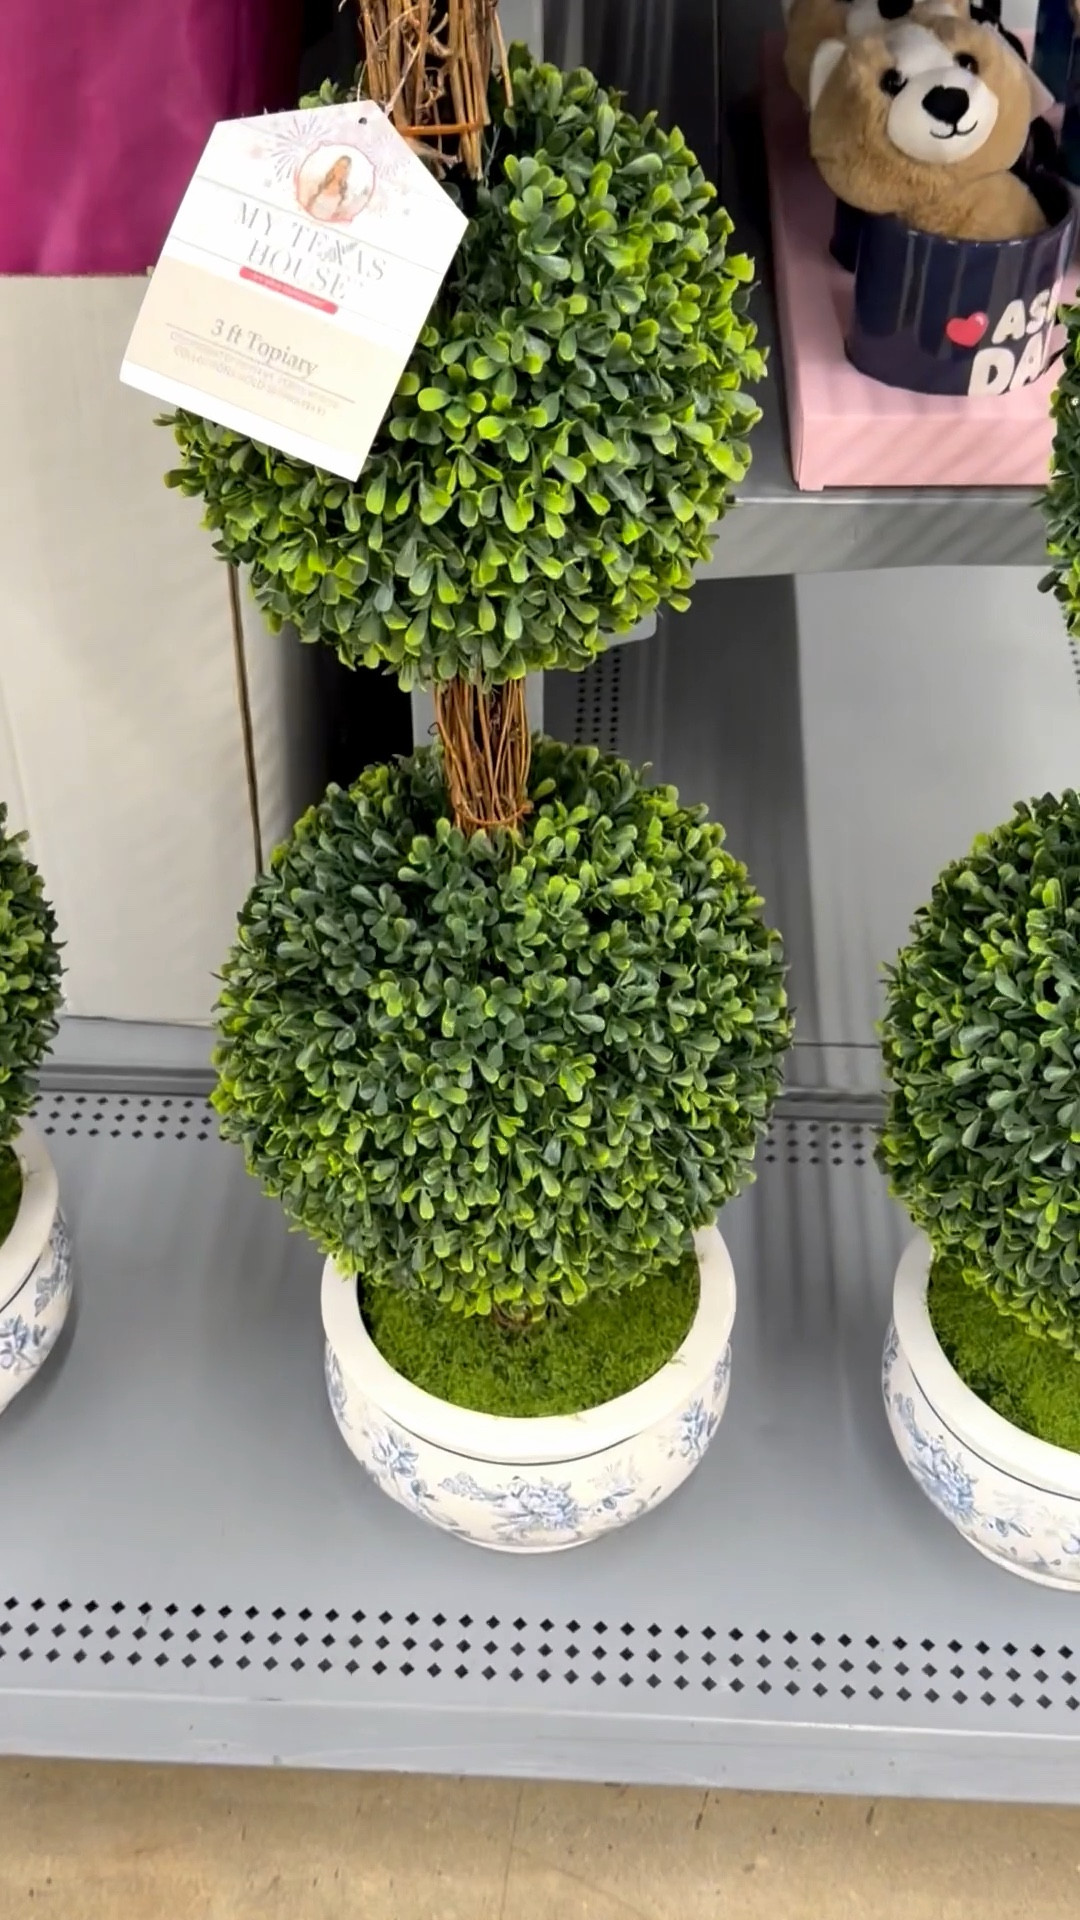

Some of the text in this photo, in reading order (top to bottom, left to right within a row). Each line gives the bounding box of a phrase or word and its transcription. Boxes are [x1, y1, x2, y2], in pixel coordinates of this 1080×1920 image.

[234, 200, 387, 281] MY TEXAS
[246, 239, 347, 300] HOUSE
[211, 318, 319, 379] 3 ft Topiary
